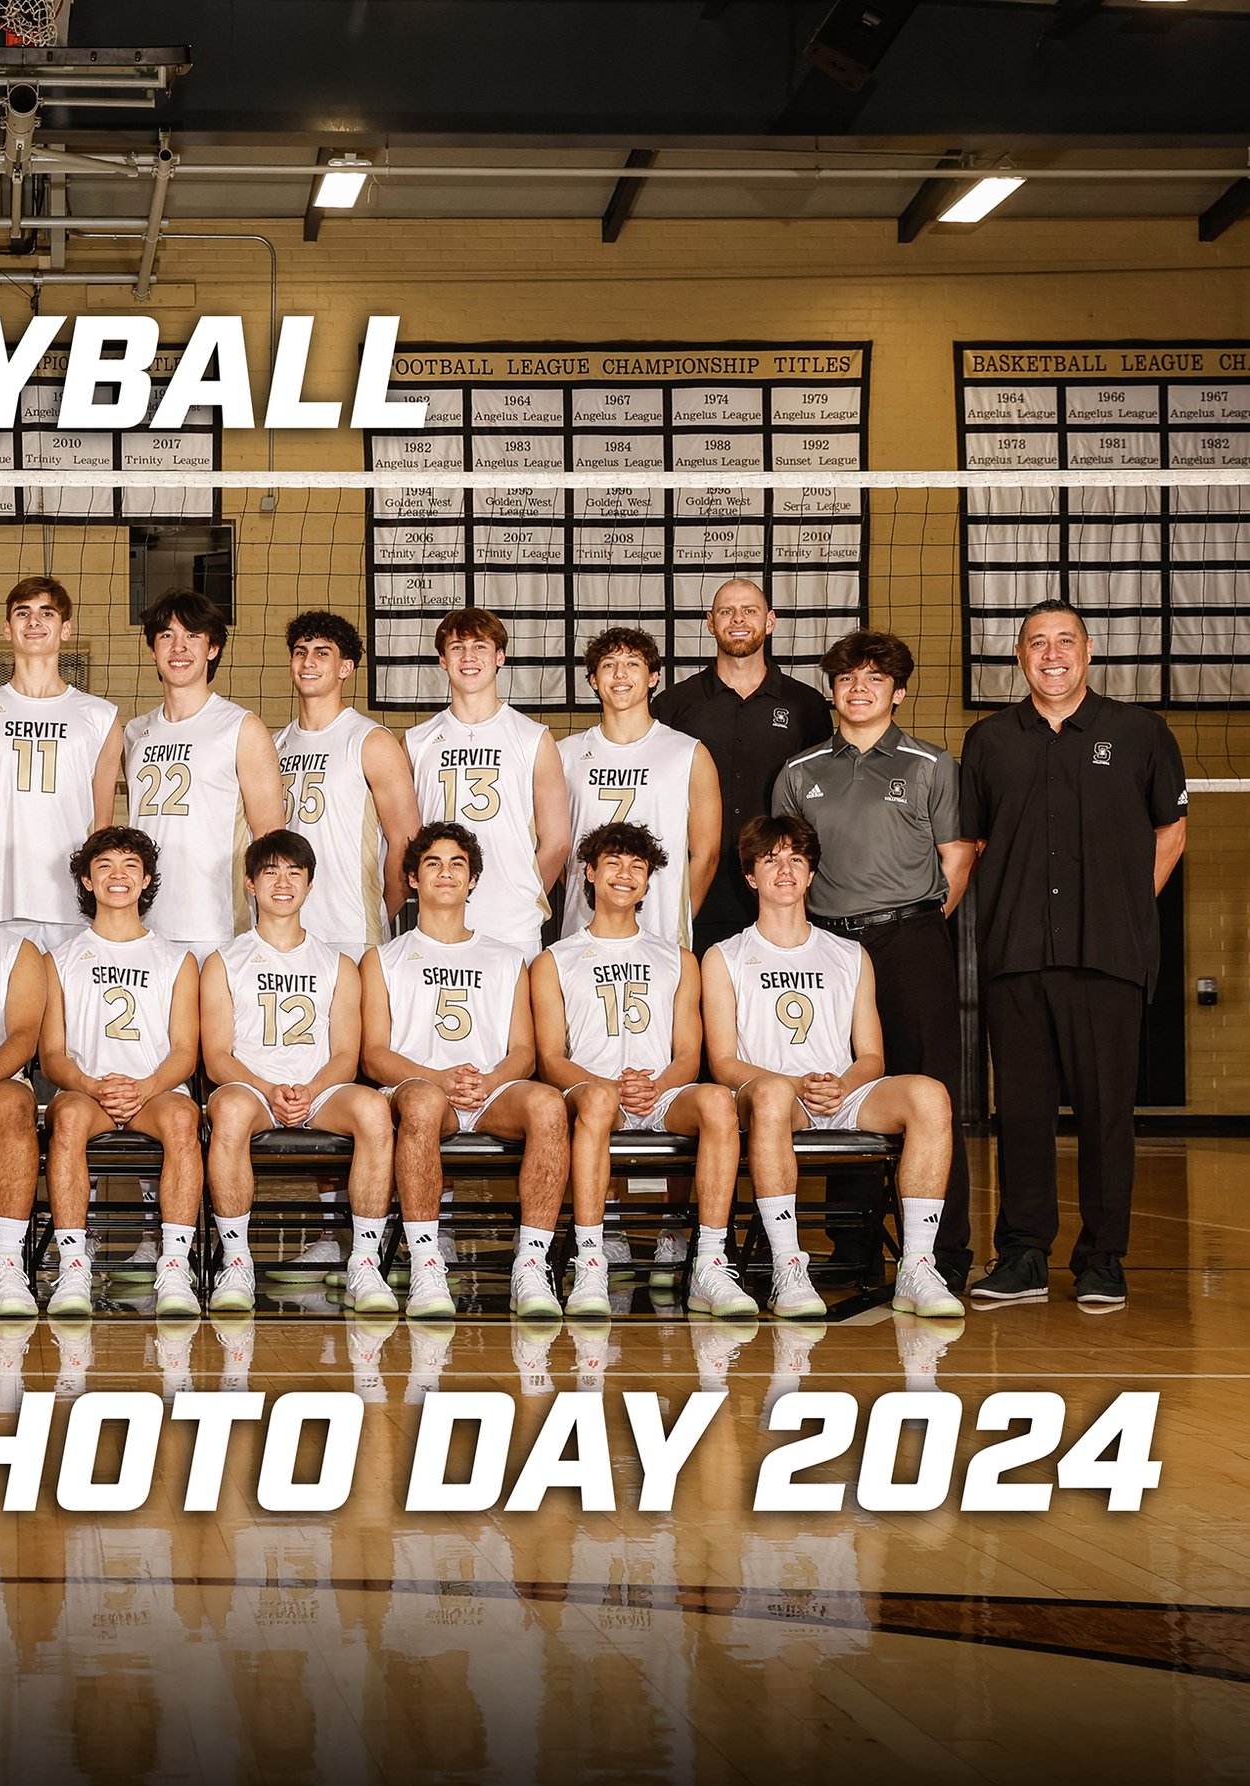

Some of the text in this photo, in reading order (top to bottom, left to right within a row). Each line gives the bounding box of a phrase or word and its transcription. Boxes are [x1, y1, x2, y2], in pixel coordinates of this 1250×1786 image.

[393, 356, 850, 375] OOTBALL LEAGUE CHAMPIONSHIP TITLES
[972, 355, 1107, 372] BASKETBALL
[1121, 354, 1203, 372] LEAGUE
[503, 396, 532, 406] 1964
[704, 394, 729, 405] 1974
[802, 394, 828, 404] 1979
[997, 394, 1024, 404] 1964
[1098, 392, 1125, 402] 1966
[1200, 392, 1229, 402] 1967
[474, 412, 563, 423] Angelus League
[674, 411, 761, 421] Angelus League
[773, 410, 858, 421] Angelus League
[967, 409, 1056, 420] Angelus League
[1068, 408, 1158, 420] Angelus League
[1170, 408, 1215, 419] Angelus
[152, 439, 181, 449] 2017
[404, 443, 432, 453] 1982
[704, 440, 731, 451] 1988
[802, 440, 829, 450] 1992
[998, 440, 1026, 450] 1978
[1201, 439, 1230, 449] 1982
[125, 455, 210, 466] Trinity League
[375, 459, 462, 469] Angelus League
[675, 457, 760, 468] Angelus League
[775, 456, 857, 466] Sunset League
[968, 455, 1057, 466] Angelus League
[1171, 454, 1216, 465] Angelus
[385, 498, 423, 507] Golden
[783, 501, 851, 512] Serra League
[802, 532, 831, 542] 2010
[820, 548, 857, 558] League
[406, 579, 432, 589] 2011
[379, 595, 461, 606] Trinity League
[4, 721, 68, 738] SERVITE
[143, 743, 193, 763] SERVITE
[440, 749, 502, 768] SERVITE
[12, 738, 58, 794] 11
[279, 754, 329, 773] SERVITE
[588, 768, 649, 786] SERVITE
[136, 763, 192, 817] 22
[438, 767, 501, 822] 13
[598, 788, 636, 822] 7
[92, 966, 150, 988] SERVITE
[423, 967, 483, 989] SERVITE
[593, 962, 651, 983] SERVITE
[257, 973, 317, 993] SERVITE
[760, 971, 824, 990] SERVITE
[102, 985, 141, 1041] 2
[434, 987, 472, 1042] 5
[595, 981, 651, 1037] 15
[257, 992, 316, 1046] 12
[775, 991, 814, 1045] 9
